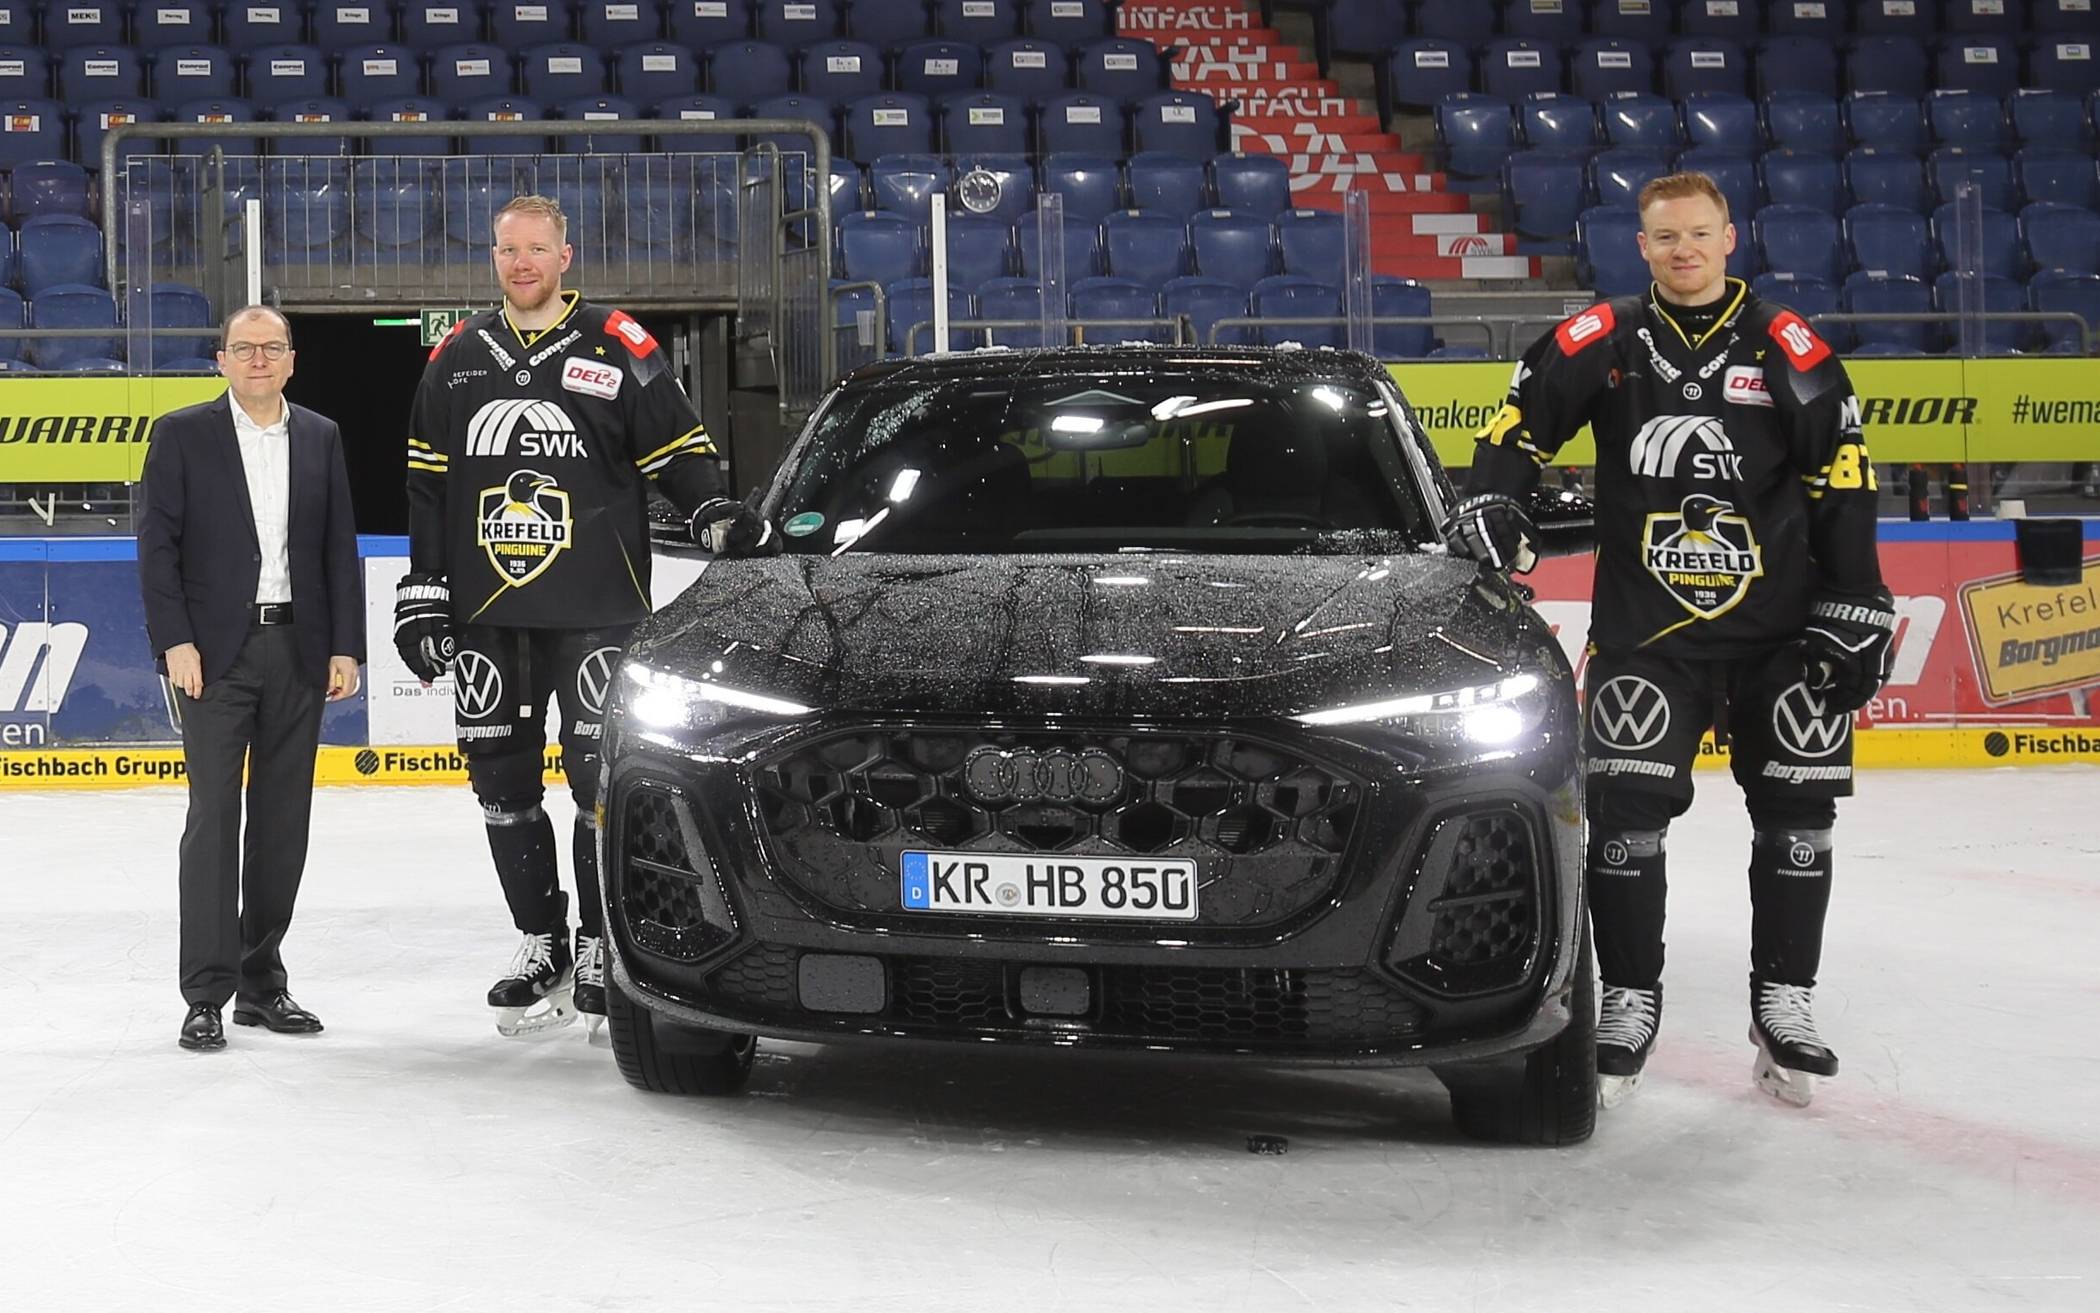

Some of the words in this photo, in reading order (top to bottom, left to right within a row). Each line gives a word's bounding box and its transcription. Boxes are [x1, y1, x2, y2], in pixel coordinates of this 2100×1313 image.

[519, 432, 588, 459] SWK
[482, 522, 566, 541] KREFELD
[495, 543, 546, 556] PINGUINE
[1647, 548, 1756, 573] KREFELD
[1668, 572, 1737, 588] PINGUINE
[393, 687, 421, 696] Das
[1588, 757, 1677, 779] Borgmann
[912, 886, 922, 899] D
[932, 861, 992, 904] KR
[1026, 864, 1087, 907] HB
[1101, 866, 1189, 909] 850
